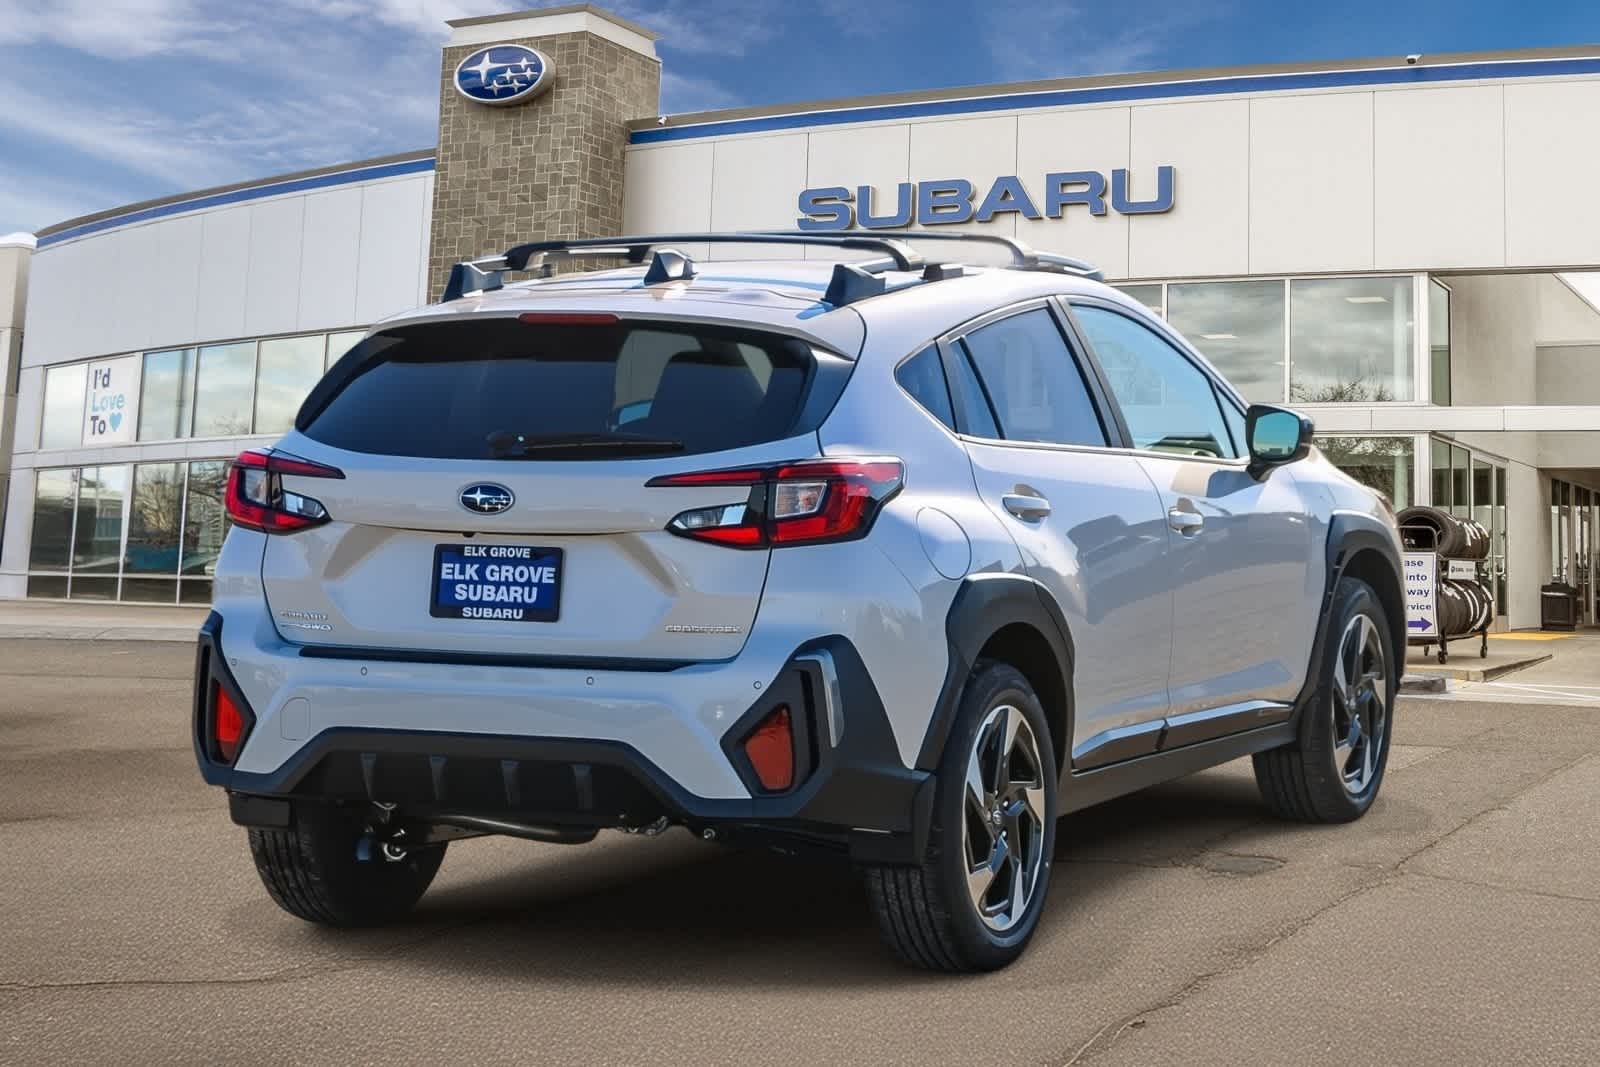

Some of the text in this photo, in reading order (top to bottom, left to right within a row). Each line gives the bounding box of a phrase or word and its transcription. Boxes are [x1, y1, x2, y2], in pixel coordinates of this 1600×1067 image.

[796, 165, 1175, 231] SUBARU
[93, 367, 111, 390] I'd
[91, 392, 125, 412] Love
[90, 415, 106, 435] To
[463, 546, 531, 559] ELK GROVE
[441, 562, 556, 584] ELK GROVE
[454, 583, 538, 604] SUBARU
[1407, 589, 1429, 597] way
[462, 607, 524, 620] SUBARU
